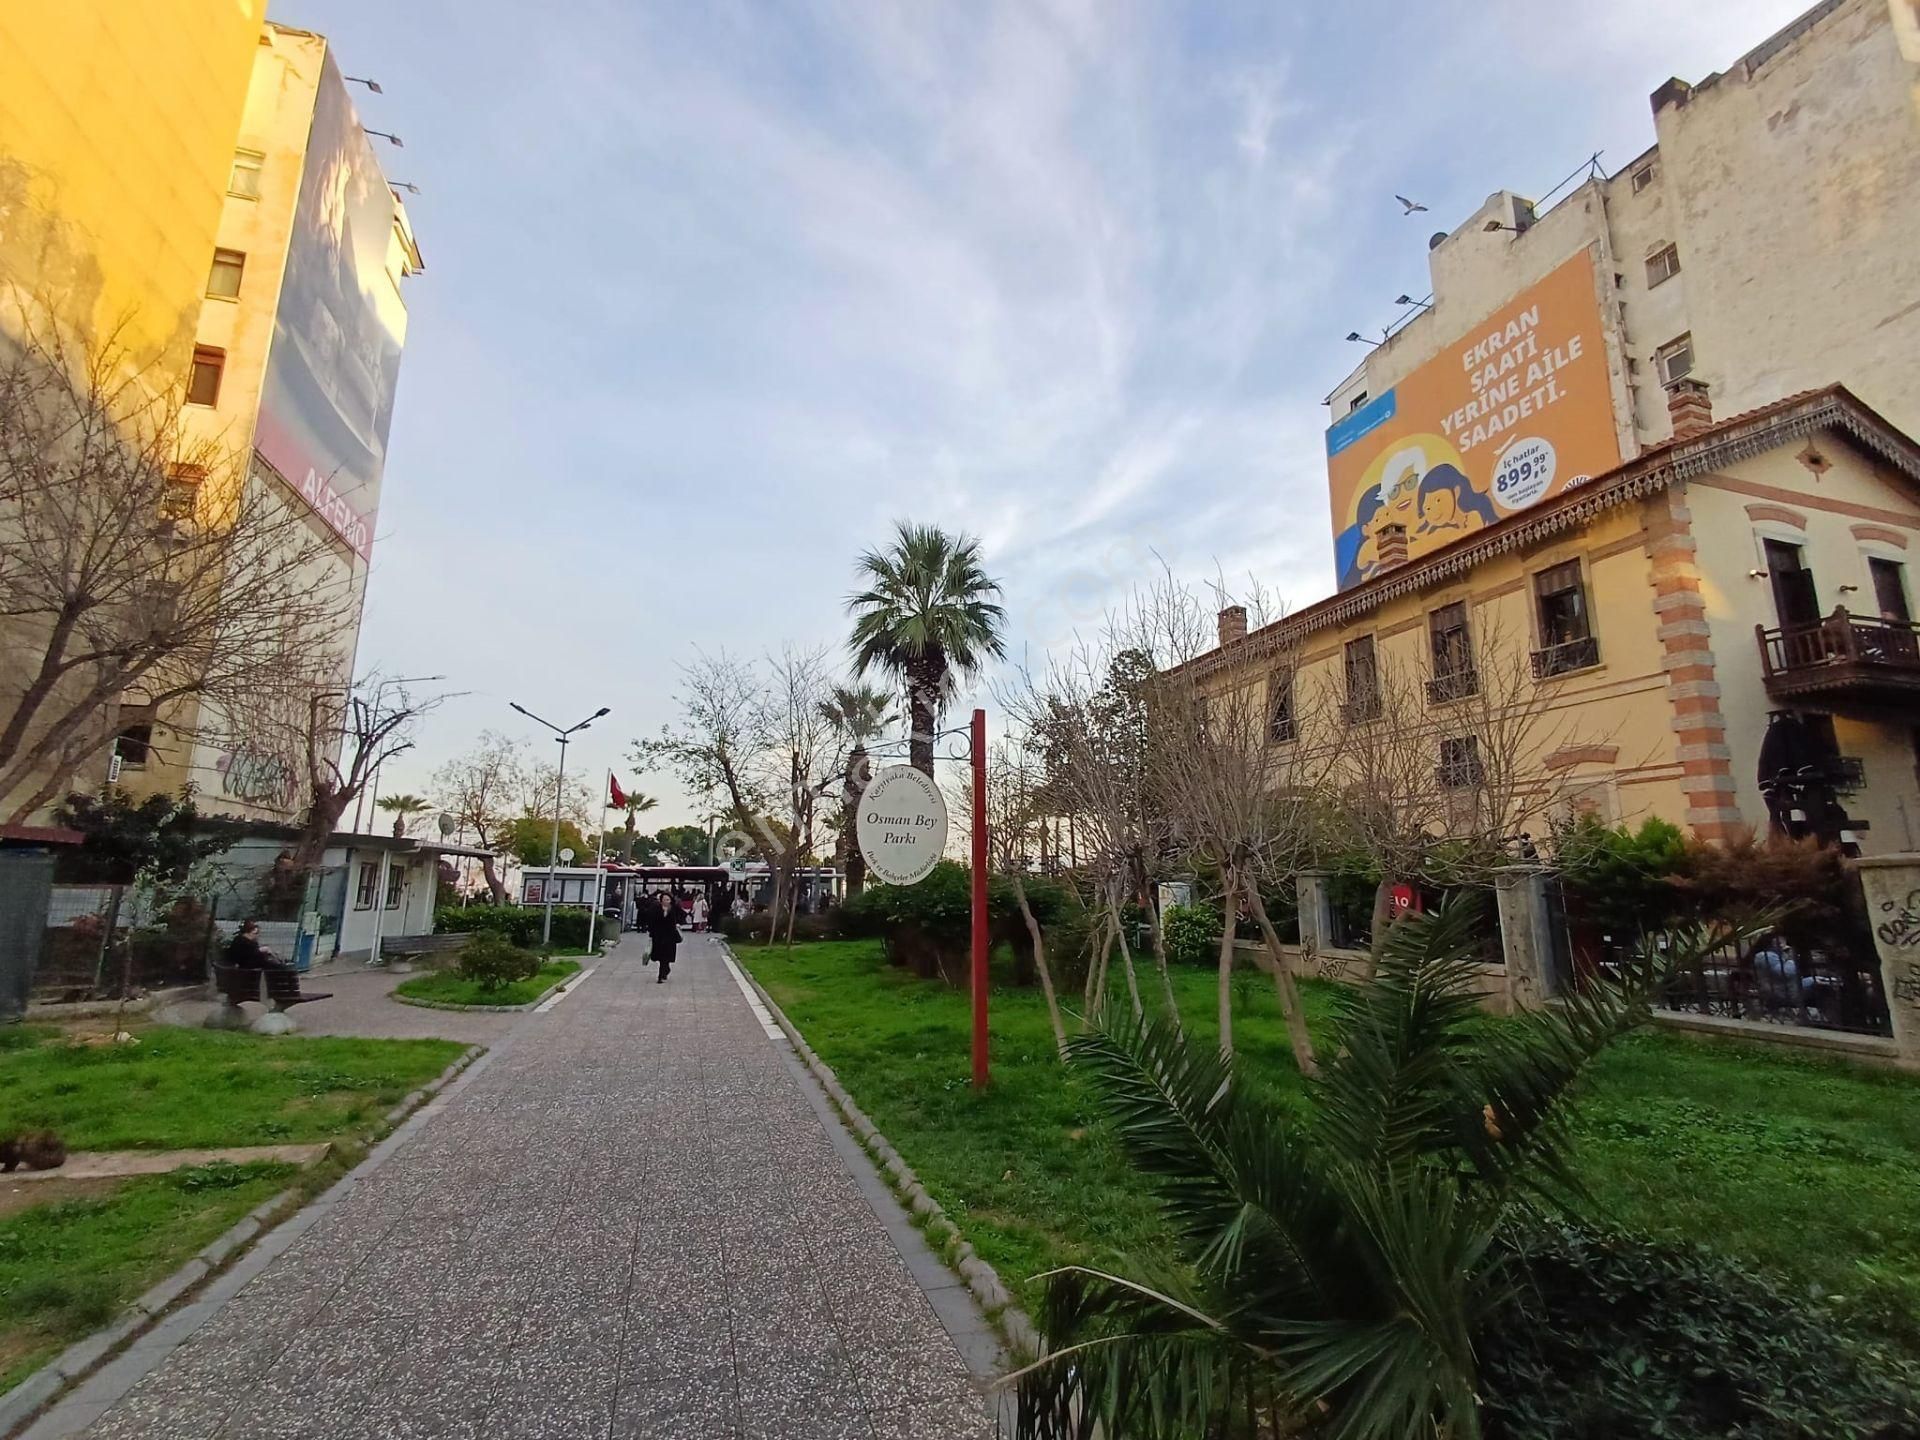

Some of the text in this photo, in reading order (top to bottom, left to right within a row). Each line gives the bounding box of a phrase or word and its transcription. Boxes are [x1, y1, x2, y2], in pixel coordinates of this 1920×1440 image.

[1462, 304, 1540, 372] EKRAN
[1470, 330, 1538, 393] SAATİ
[1440, 334, 1583, 436] YERİNE AİLE
[1458, 375, 1567, 453] SAADETİ.
[1512, 445, 1539, 465] hatlar
[303, 467, 367, 552] ALFEMO
[867, 812, 938, 830] Osman Bey
[883, 832, 917, 844] Parkı
